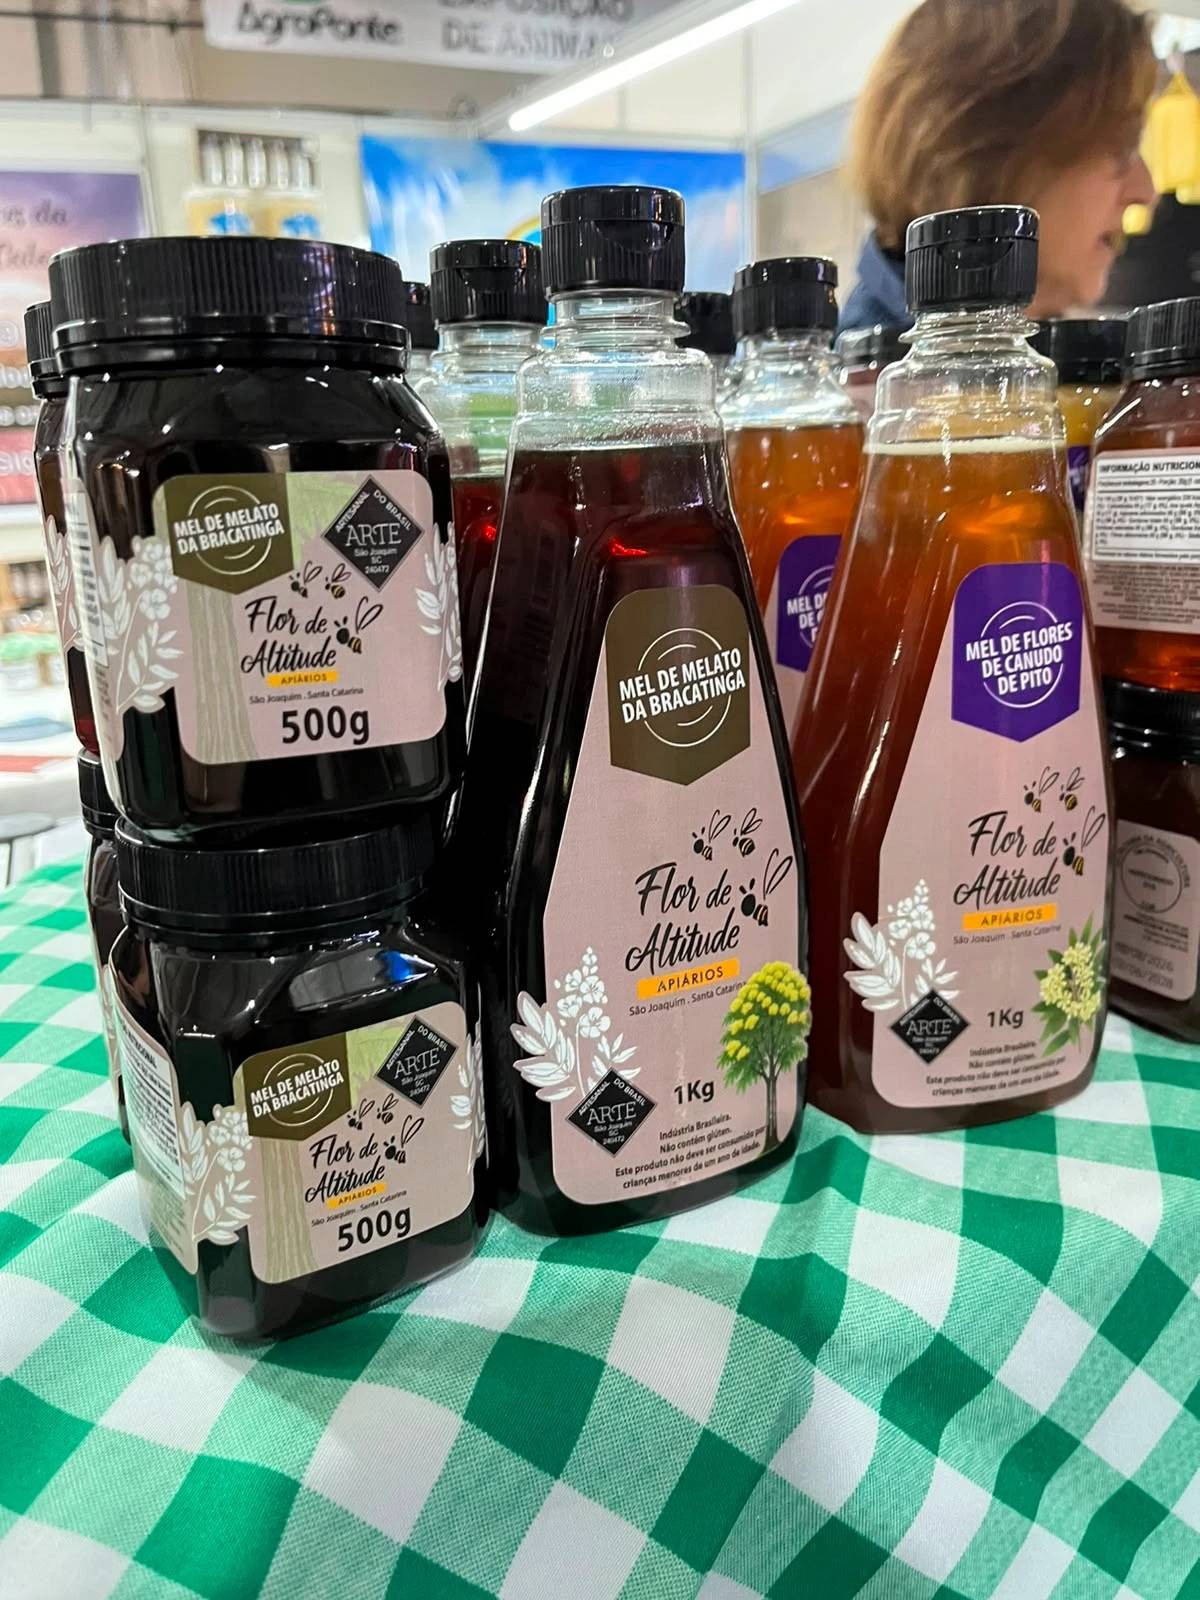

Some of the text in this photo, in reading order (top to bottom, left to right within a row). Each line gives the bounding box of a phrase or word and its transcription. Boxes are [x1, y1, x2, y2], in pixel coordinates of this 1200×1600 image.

[1099, 461, 1150, 474] INFORMAÇÃO
[174, 503, 279, 538] MEL DE MELATO
[335, 489, 412, 532] ARTESANAL DO BRASIL
[177, 521, 285, 555] DA BRACATINGA
[344, 523, 402, 546] ARTE
[244, 595, 328, 636] Flor de
[787, 594, 813, 616] MEL
[799, 612, 814, 629] DE
[240, 635, 337, 677] Altitude
[965, 622, 1073, 662] MEL DE FLORES
[619, 648, 742, 701] MEL DE MELATO
[981, 644, 1063, 679] DE CANUDO
[280, 671, 328, 685] APIÁRIOS
[998, 670, 1052, 696] DE PITO
[249, 686, 364, 705] São Joaquim Santa Catarina
[622, 668, 745, 724] DA BRACATINGA
[281, 705, 370, 745] 500g
[968, 810, 1056, 859] Flor de
[635, 861, 732, 917] Flor de
[953, 858, 1061, 911] Altitude
[981, 909, 1042, 927] APIÁRIOS
[625, 907, 741, 975] Altitude
[953, 934, 969, 945] São
[970, 933, 1005, 946] Joaquim
[1011, 929, 1031, 940] Santa
[657, 966, 723, 993] APIÁRIOS
[629, 1005, 646, 1016] São
[648, 999, 686, 1015] Joaquim
[691, 990, 713, 1002] Santa
[906, 1019, 952, 1036] ARTE
[988, 1008, 1024, 1029] 1Kg
[418, 1025, 428, 1036] DO
[428, 1033, 449, 1052] BRASIL
[394, 1047, 440, 1079] ARTE
[251, 1059, 340, 1105] MEL DE MELATO
[253, 1071, 344, 1118] DA BRACATINGA
[613, 1078, 625, 1089] DO
[624, 1086, 647, 1106] BRASIL
[674, 1079, 715, 1105] 1Kg
[932, 1085, 963, 1096] crianças
[587, 1101, 637, 1126] ARTE
[660, 1123, 694, 1140] Indústria
[660, 1127, 732, 1153] Não contém glúten.
[309, 1133, 378, 1169] Flor de
[615, 1126, 767, 1177] Este produto não deve ser consumido por
[305, 1156, 385, 1203] Altitude
[623, 1176, 657, 1189] crianças
[658, 1167, 692, 1181] menores
[693, 1162, 703, 1171] de
[705, 1159, 716, 1168] um
[717, 1154, 730, 1163] ano
[732, 1148, 740, 1159] de
[338, 1186, 377, 1205] APIÁRIOS
[311, 1218, 325, 1226] São
[326, 1208, 356, 1224] Joaquim
[360, 1199, 378, 1211] Santa
[338, 1207, 412, 1252] 500g
